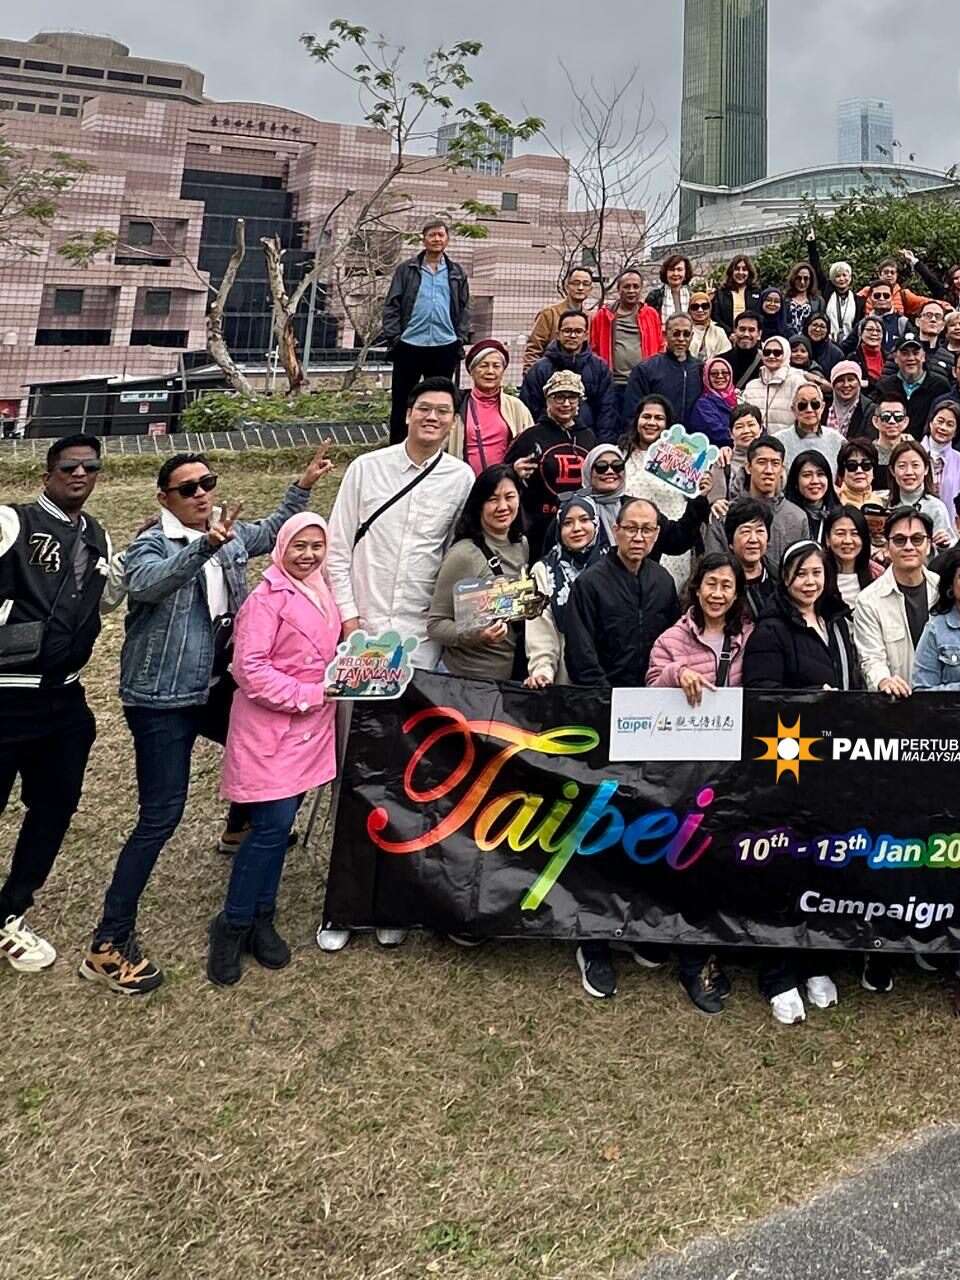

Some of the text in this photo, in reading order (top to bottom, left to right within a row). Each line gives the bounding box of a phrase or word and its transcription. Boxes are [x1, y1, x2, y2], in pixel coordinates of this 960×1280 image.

[29, 522, 61, 572] 74
[336, 668, 403, 682] TAIWAN
[617, 717, 652, 733] taipei
[832, 738, 899, 761] PAM
[367, 706, 716, 910] Taipei
[738, 833, 789, 861] 10th
[816, 834, 867, 862] 13th
[872, 840, 921, 863] Jan
[799, 890, 955, 929] Campaign
